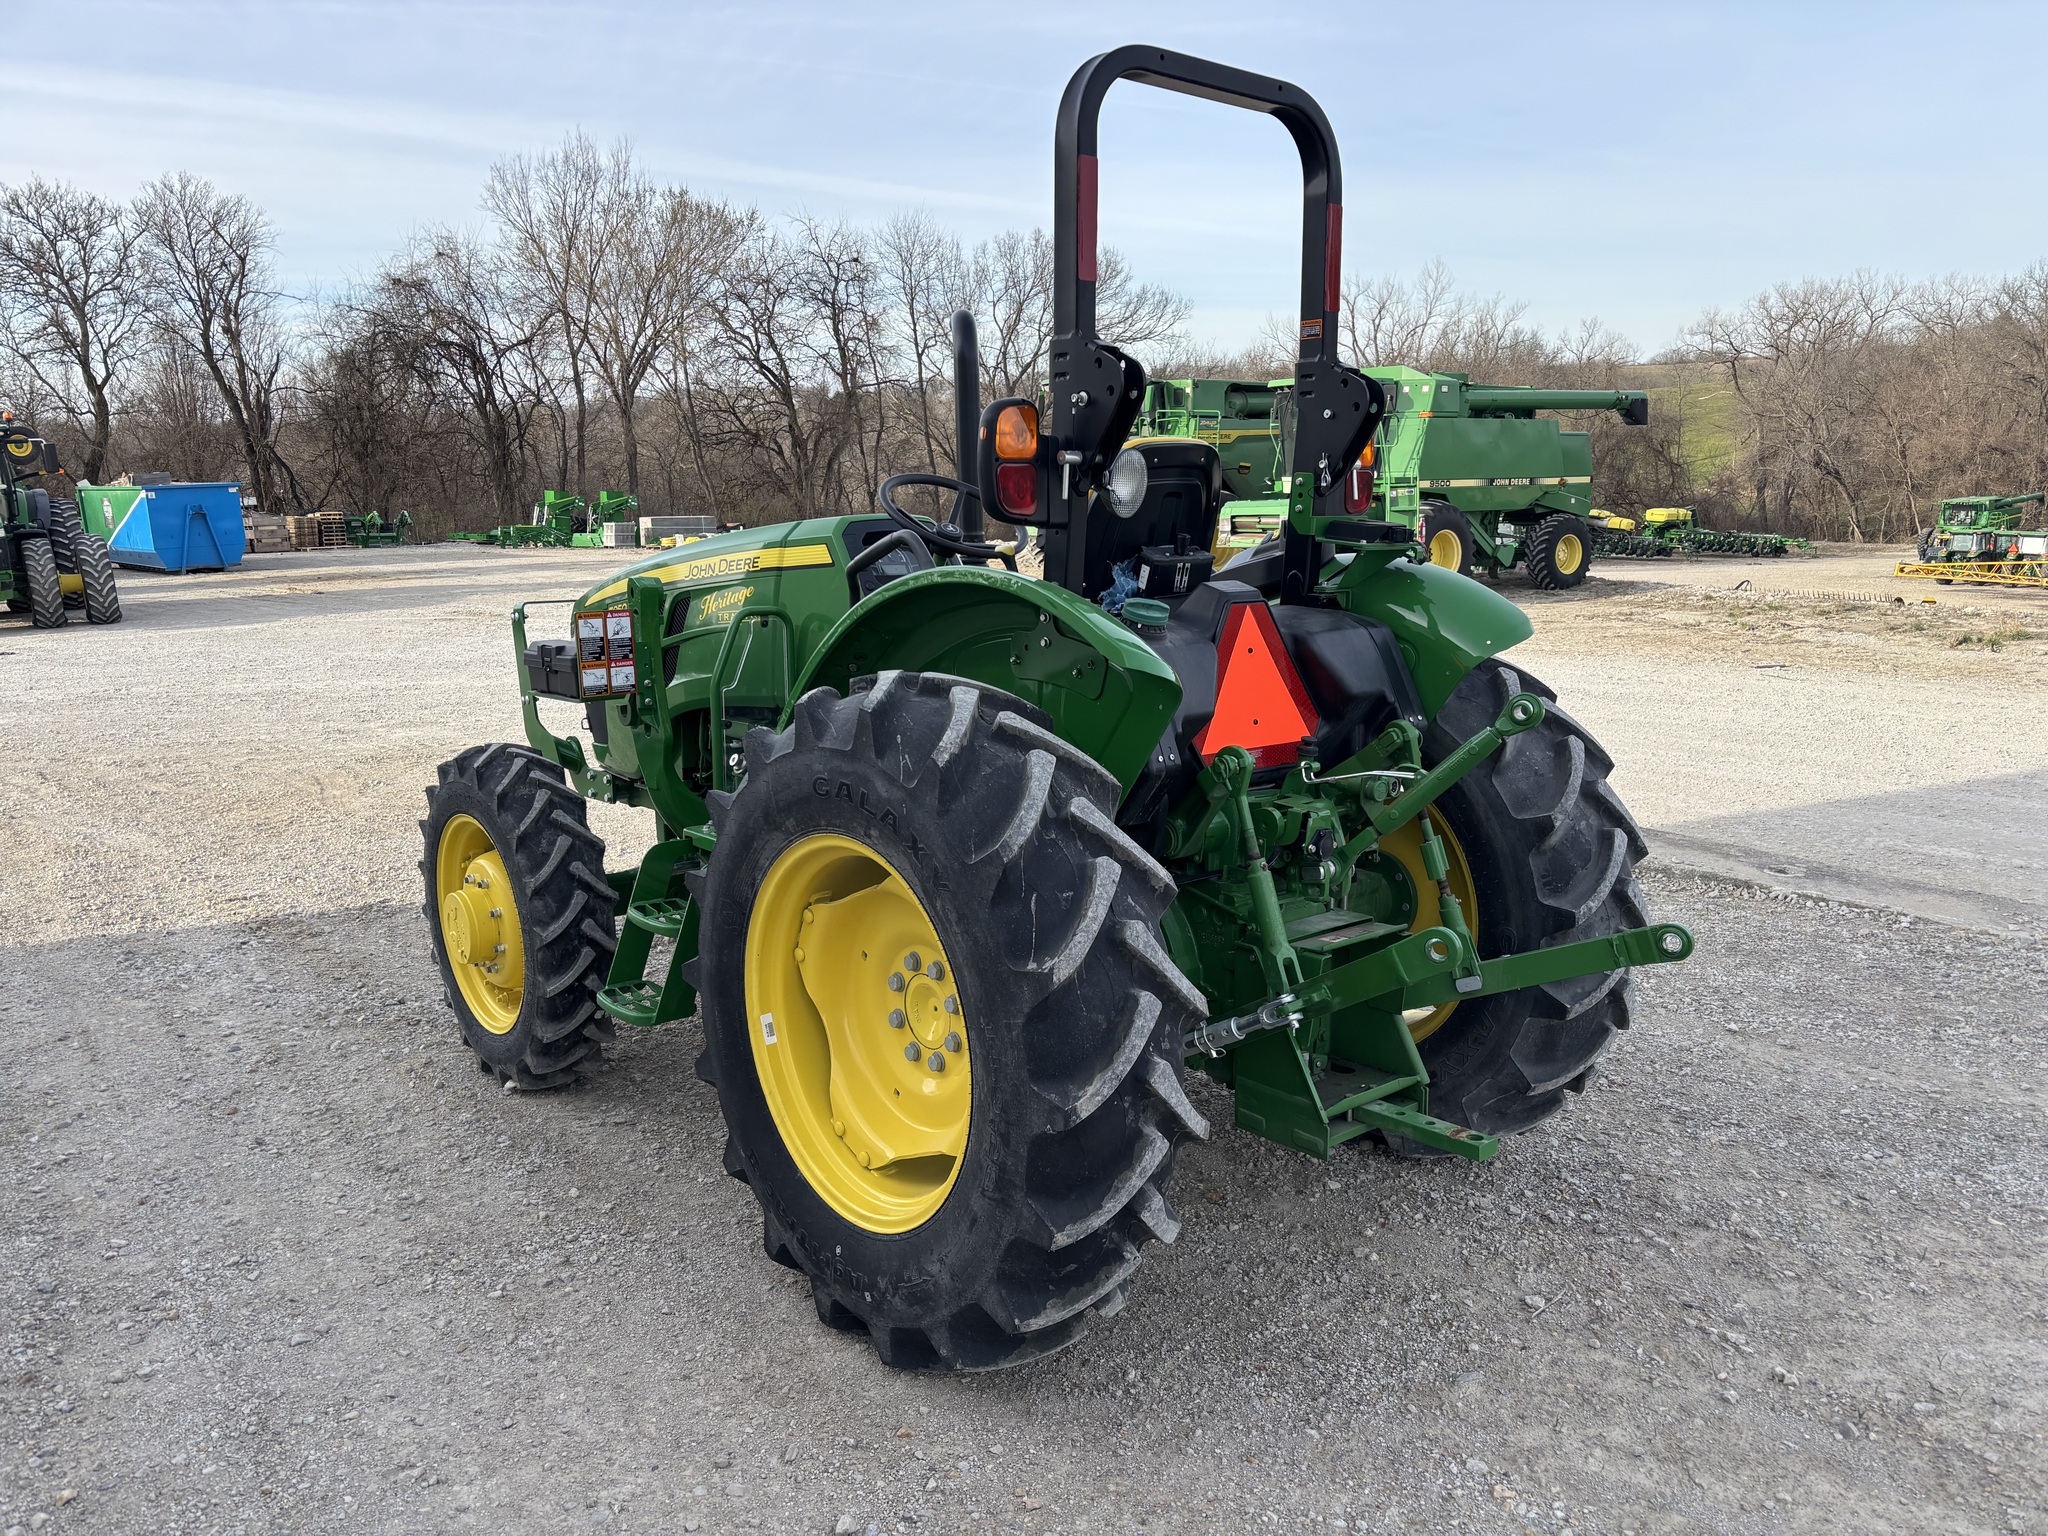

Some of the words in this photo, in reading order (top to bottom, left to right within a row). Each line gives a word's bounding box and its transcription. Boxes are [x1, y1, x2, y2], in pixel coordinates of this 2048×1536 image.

[1429, 480, 1451, 488] 9500
[1492, 478, 1509, 486] JOHN
[1510, 478, 1530, 486] DEERE
[684, 562, 717, 580] JOHN
[718, 556, 760, 575] DEERE
[699, 586, 754, 620] Heritage
[812, 774, 953, 892] GALAXY
